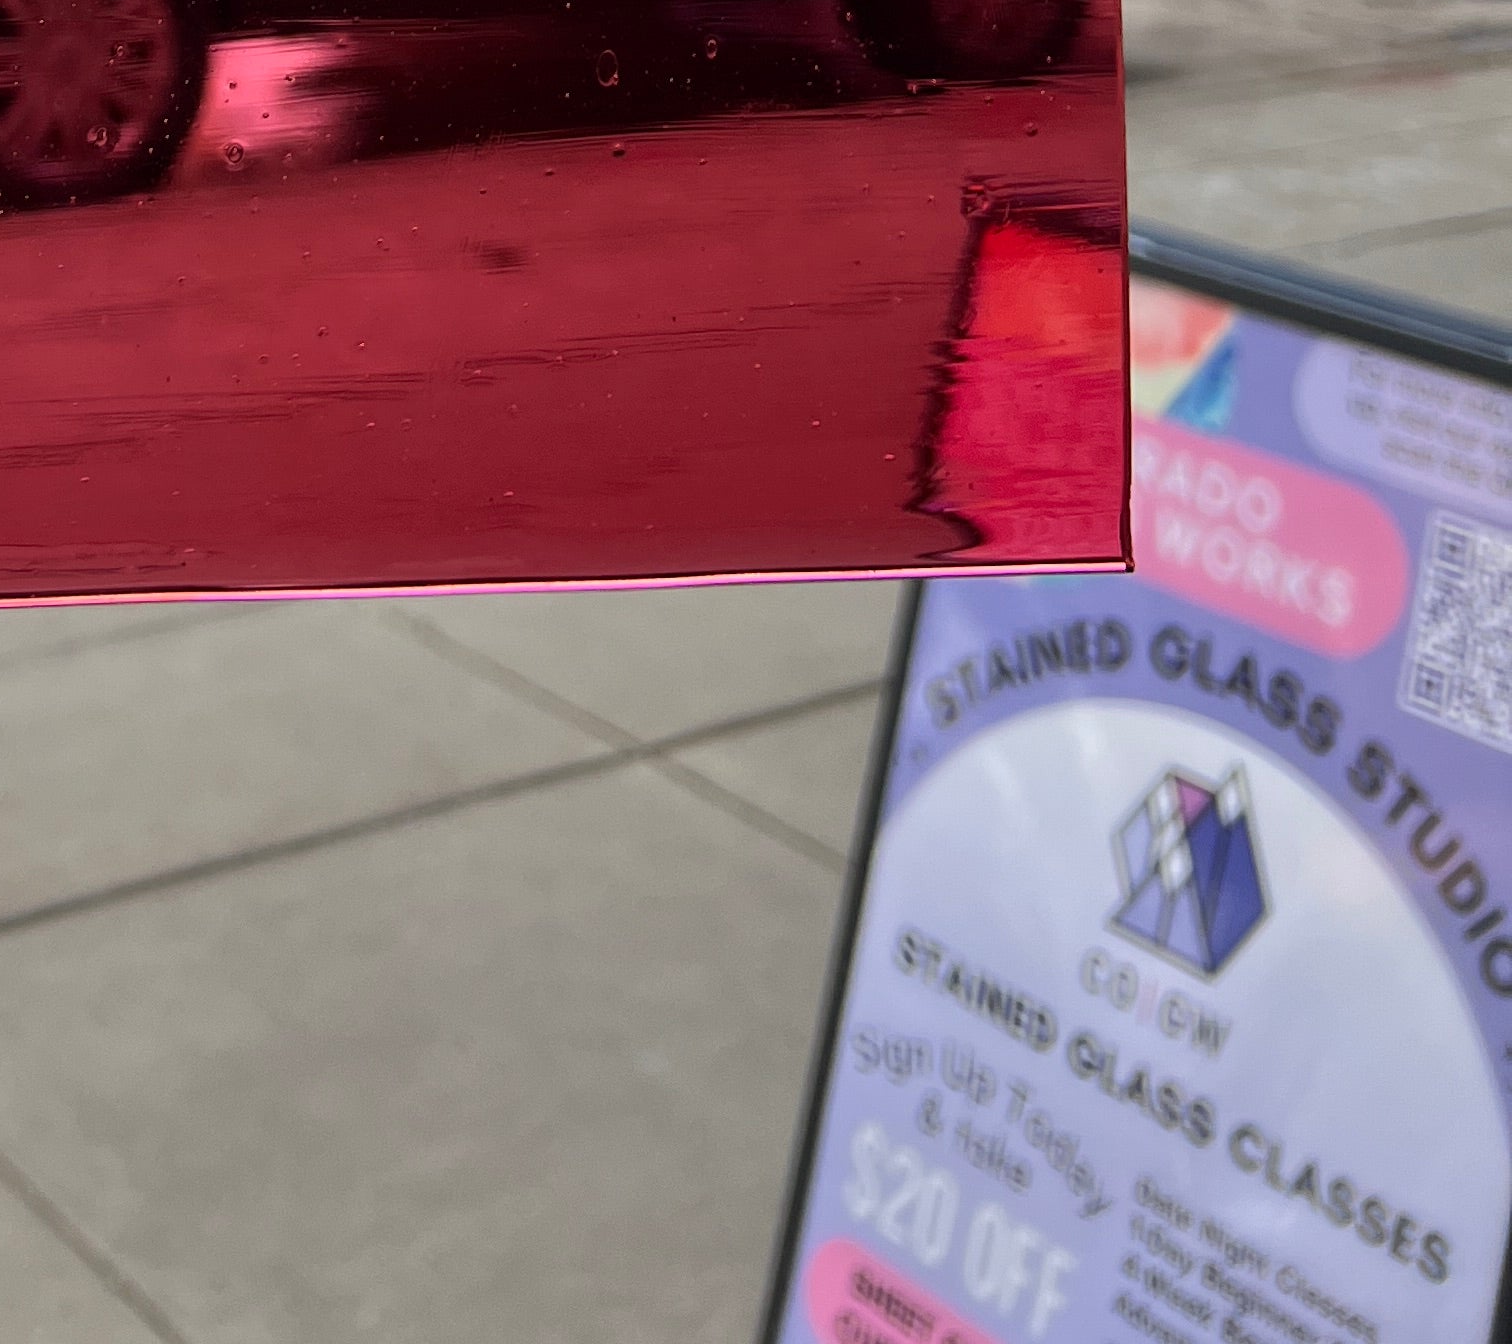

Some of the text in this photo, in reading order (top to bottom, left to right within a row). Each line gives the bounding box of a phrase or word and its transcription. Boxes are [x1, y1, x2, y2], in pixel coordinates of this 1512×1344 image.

[1154, 509, 1356, 629] WORKS
[925, 617, 1512, 999] STAINED GLASS STUDIO
[893, 927, 1452, 1286] STAINED GLASS CLASSES
[941, 1037, 997, 1106] Up
[844, 1122, 1080, 1339] $20 OFF
